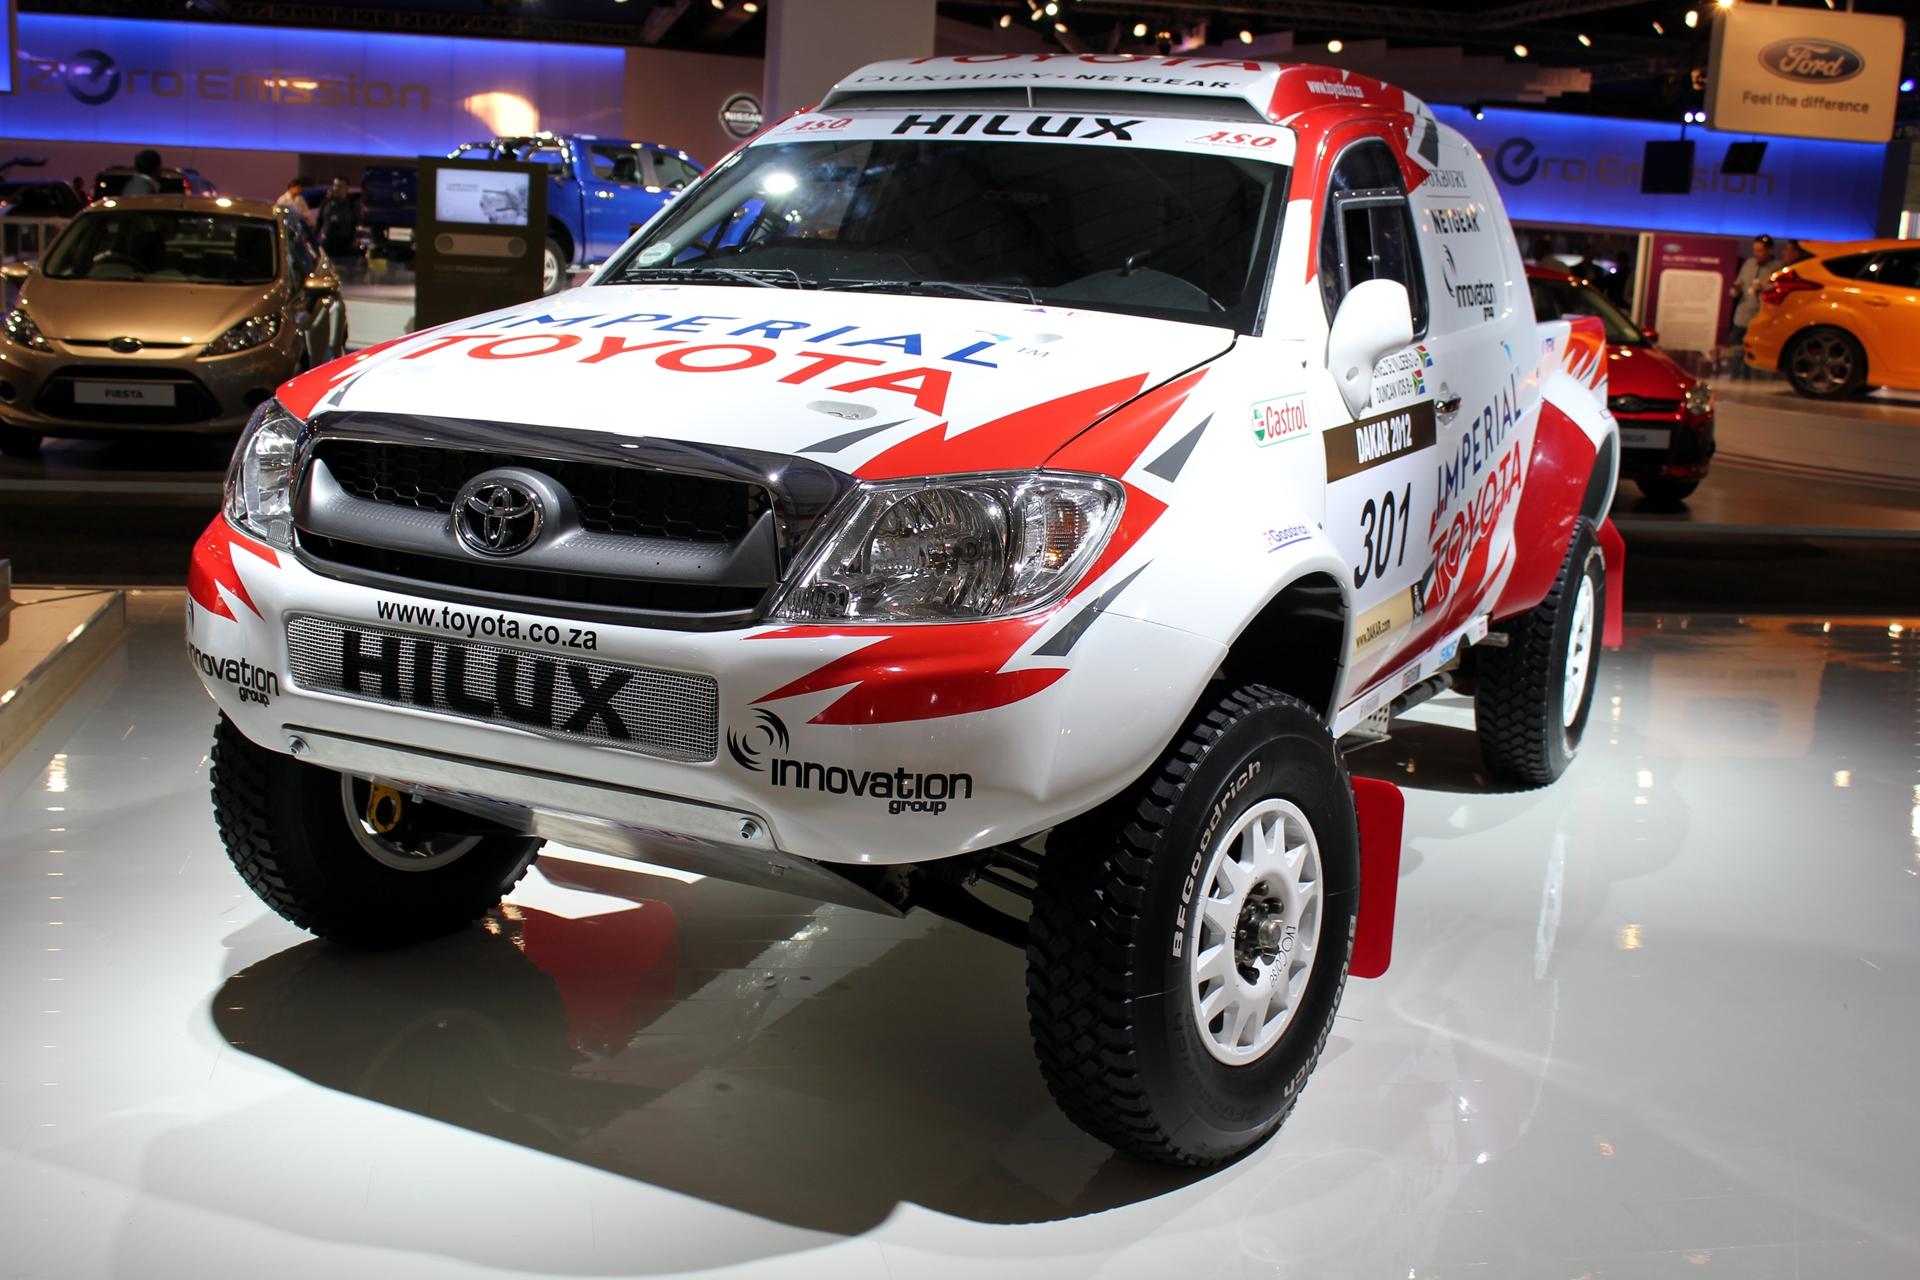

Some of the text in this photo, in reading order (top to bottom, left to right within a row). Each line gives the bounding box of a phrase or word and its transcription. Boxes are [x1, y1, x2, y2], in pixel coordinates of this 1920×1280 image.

[1073, 73, 1232, 88] NETGEAR
[1779, 43, 1845, 77] Ford
[1742, 90, 1870, 113] Feel the difference
[890, 114, 1147, 141] HILUX
[1431, 208, 1480, 234] NETGEAR
[464, 313, 999, 368] IMPERIAL
[104, 388, 145, 399] FIESTA
[400, 333, 953, 417] TOYOTA
[1265, 400, 1308, 438] Castrol
[1355, 413, 1413, 464] DAKAR 2012
[1436, 373, 1522, 520] IMPERIAL
[1354, 482, 1412, 590] 301
[1431, 438, 1523, 603] TOYOTA
[376, 600, 597, 650] www.toyota.co.za
[239, 686, 271, 707] group
[342, 630, 634, 740] HILUX
[771, 758, 973, 800] innovation
[888, 799, 948, 815] group
[1171, 759, 1263, 959] BFGoodrich
